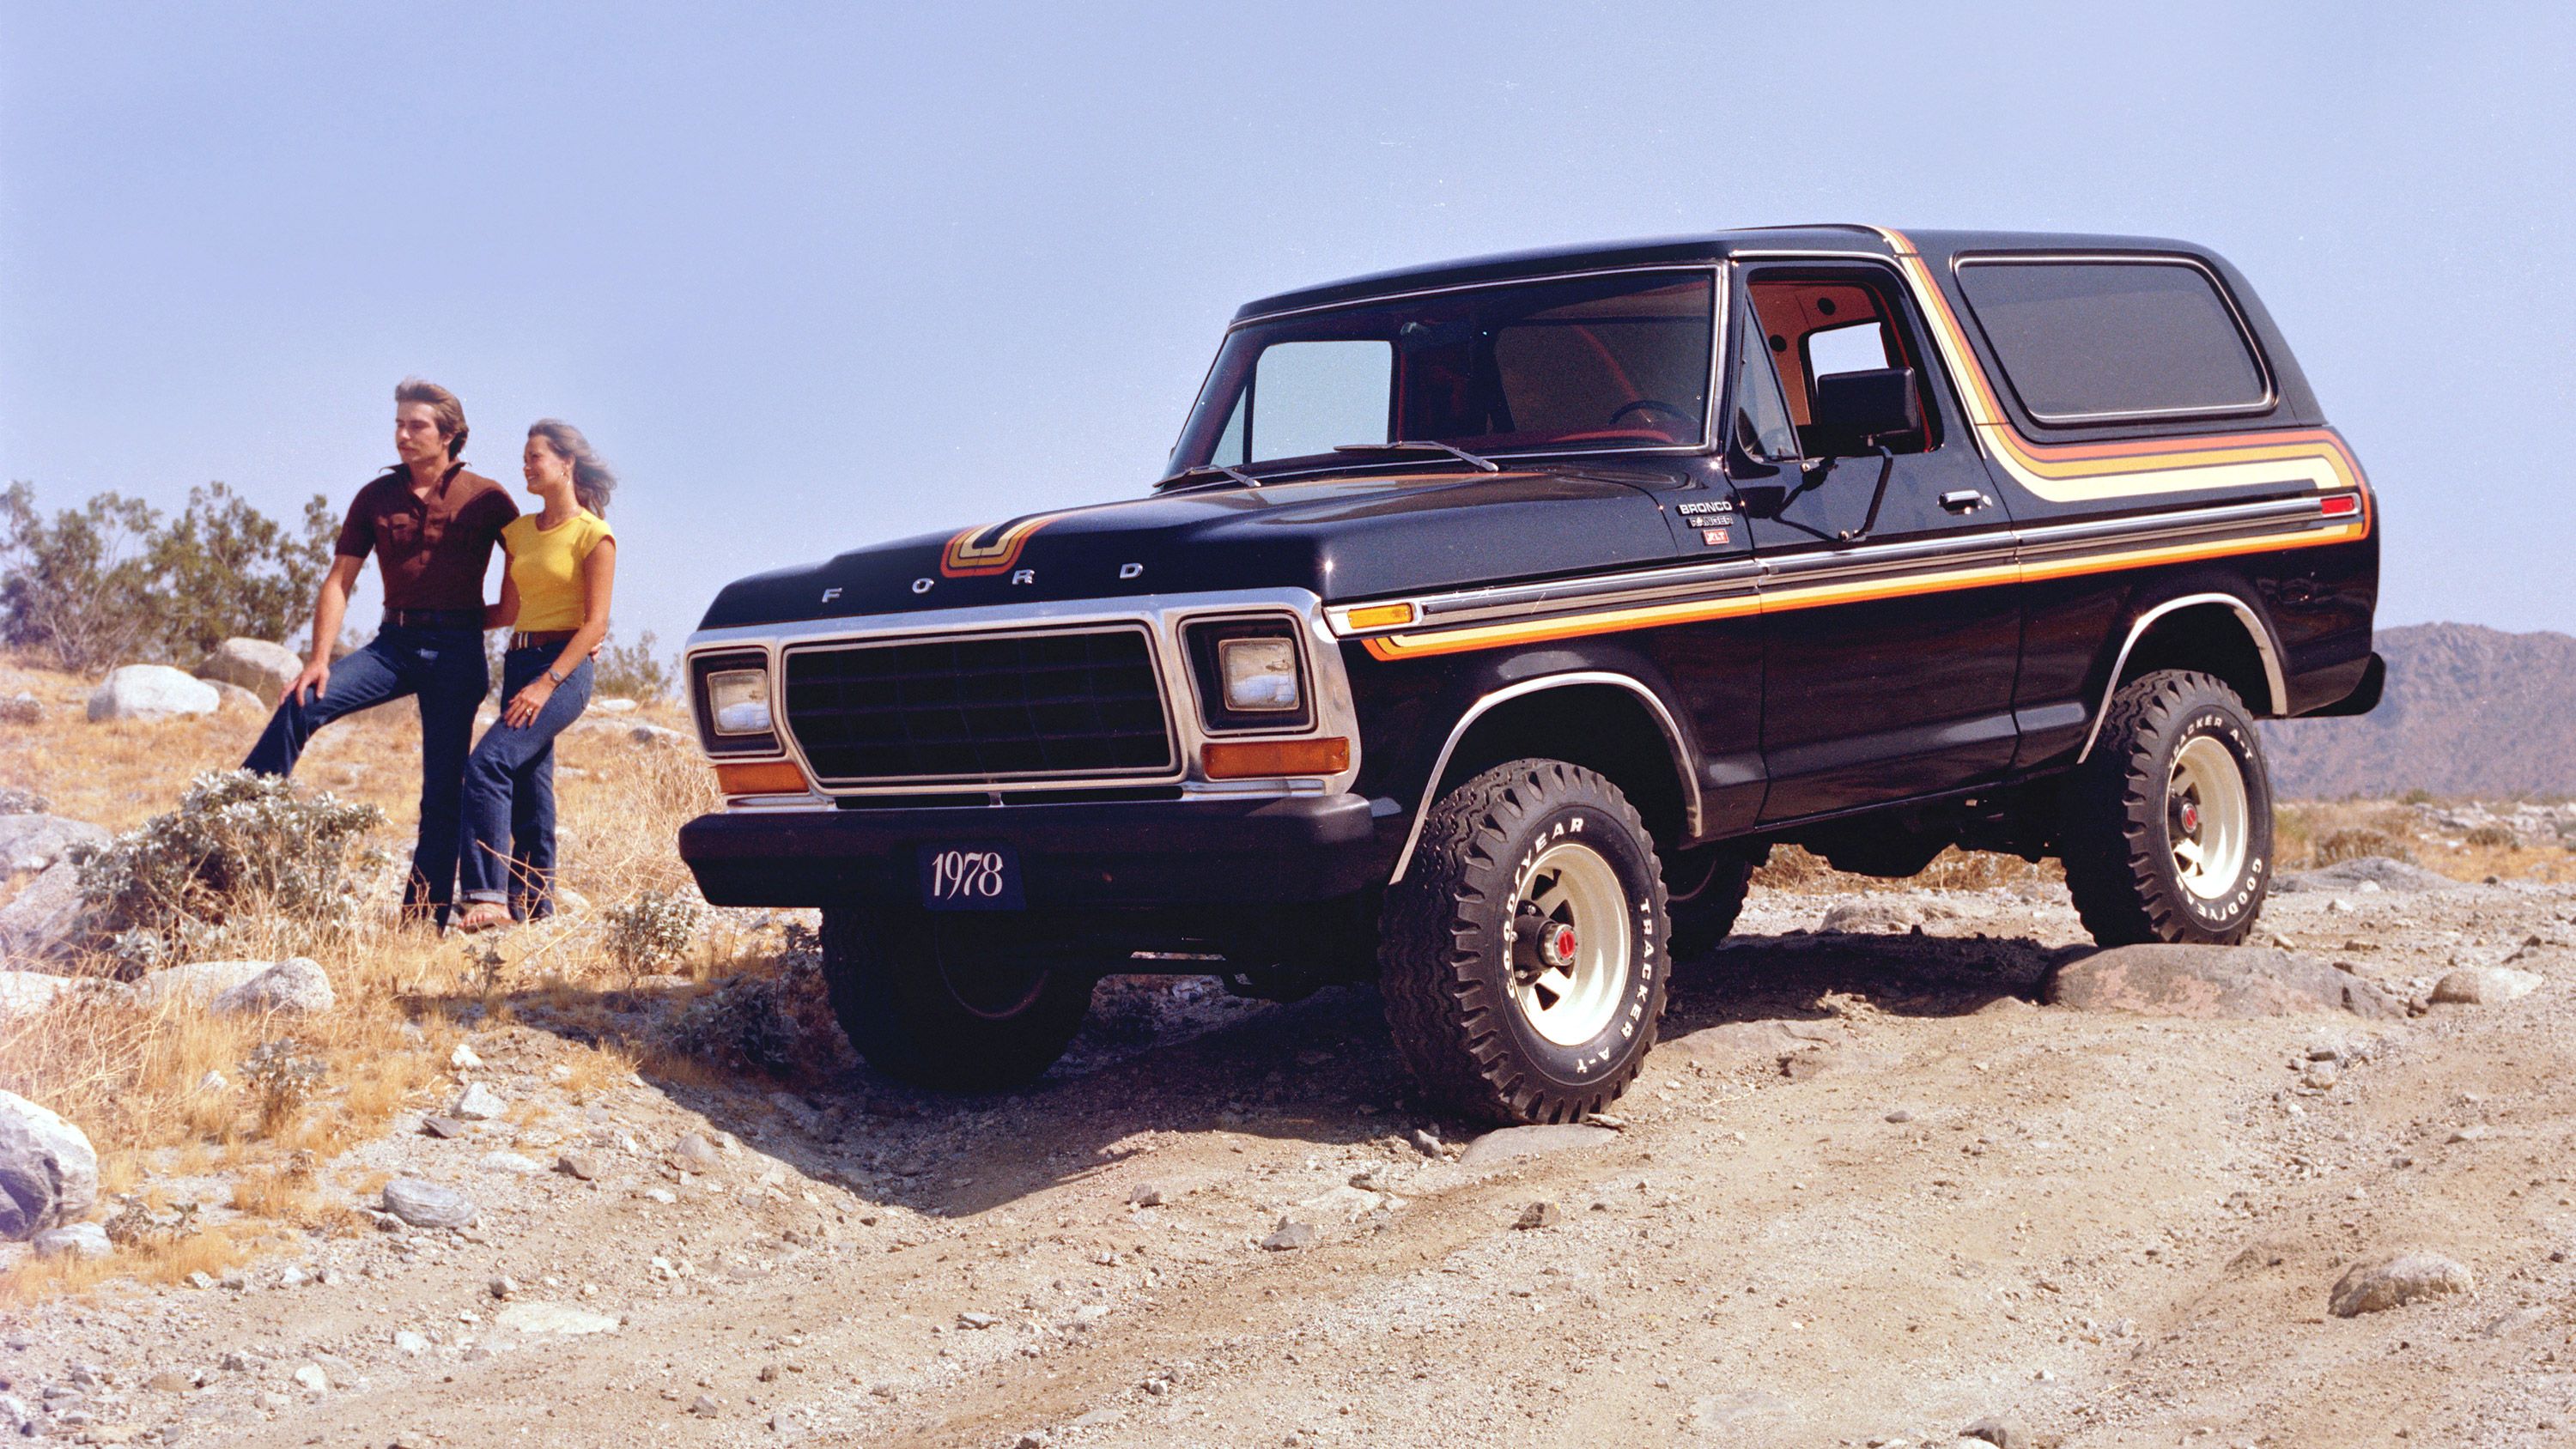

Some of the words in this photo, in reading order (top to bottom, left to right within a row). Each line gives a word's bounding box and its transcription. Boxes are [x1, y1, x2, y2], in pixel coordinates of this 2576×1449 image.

[1679, 501, 1733, 514] BRONCO
[1689, 516, 1734, 527] RANGER
[1707, 531, 1726, 543] XLT
[822, 562, 1144, 603] FORD
[2168, 714, 2222, 769] TRACKER
[2230, 729, 2253, 759] A-T
[932, 851, 1004, 900] 1978
[2176, 858, 2263, 921] GOODYEAR
[1504, 818, 1583, 998] GOODYEAR
[1620, 898, 1654, 1040] TRACKER
[1577, 1046, 1610, 1073] A-T
